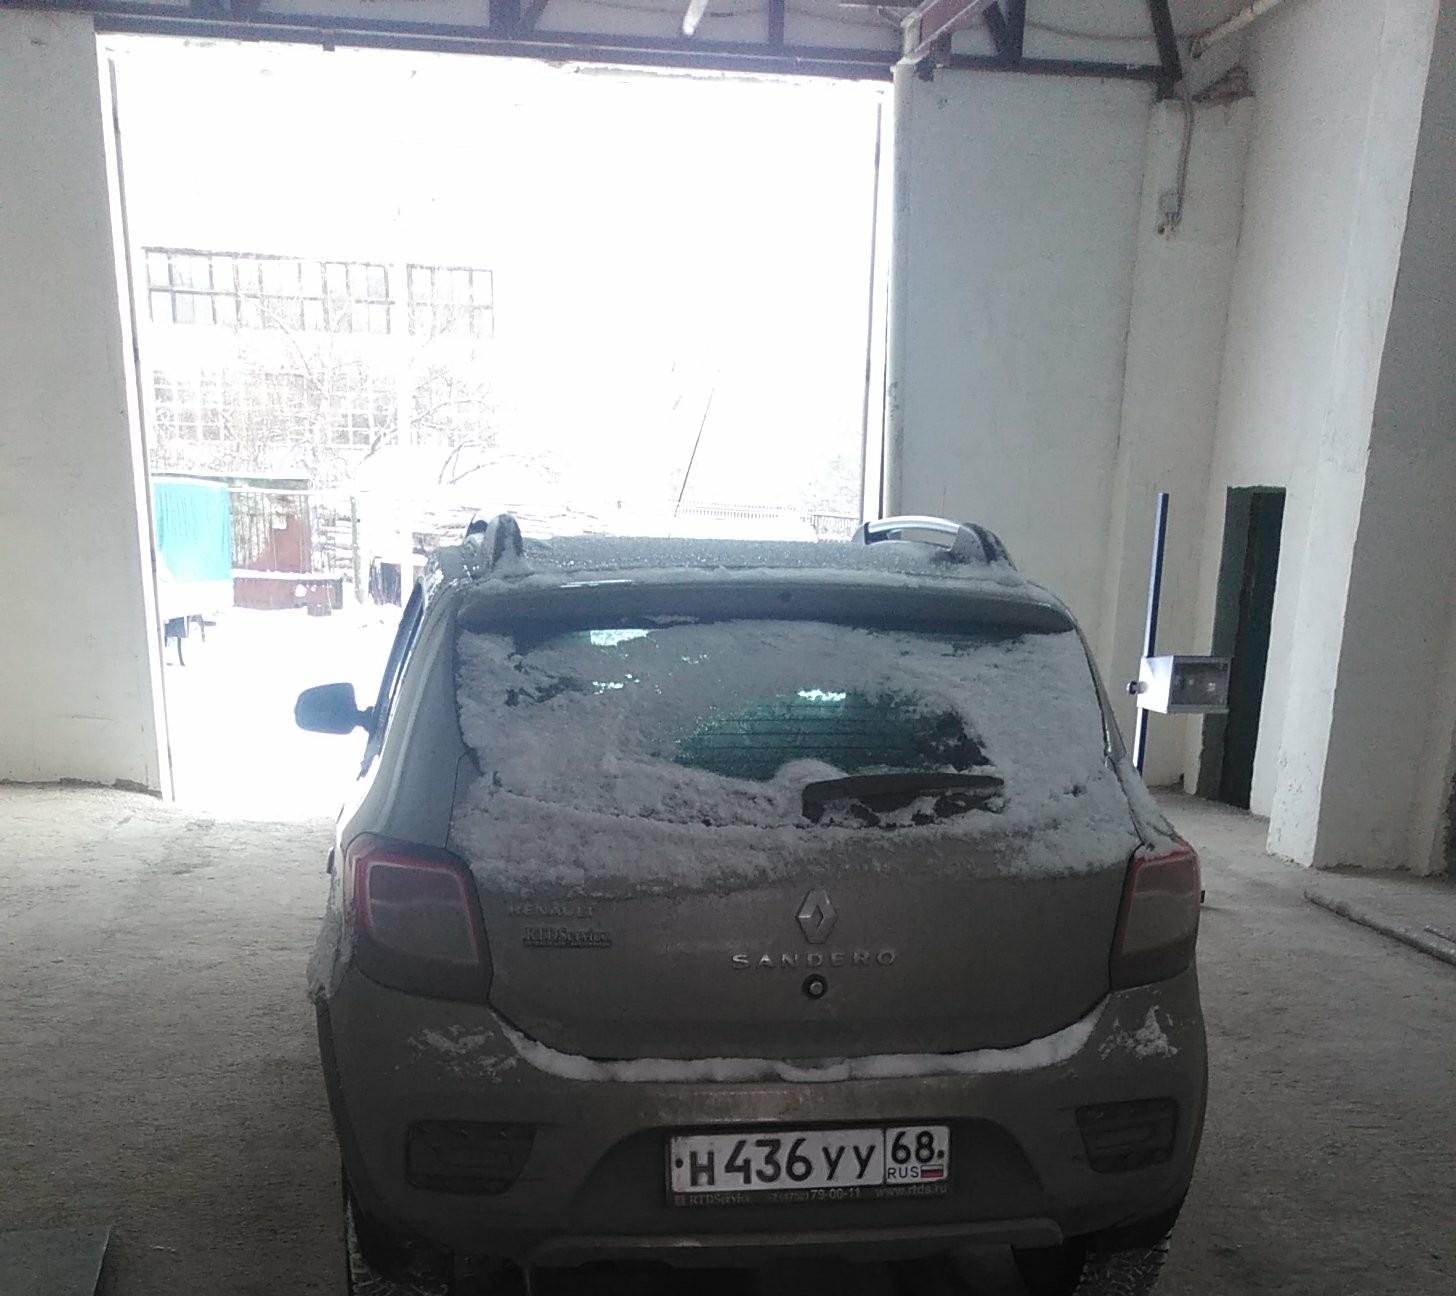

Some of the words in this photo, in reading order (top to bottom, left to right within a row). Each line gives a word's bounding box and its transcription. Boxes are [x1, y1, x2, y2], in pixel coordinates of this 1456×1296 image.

[730, 950, 898, 969] SANDERO
[890, 1131, 935, 1164] 68
[887, 1167, 920, 1179] RUS
